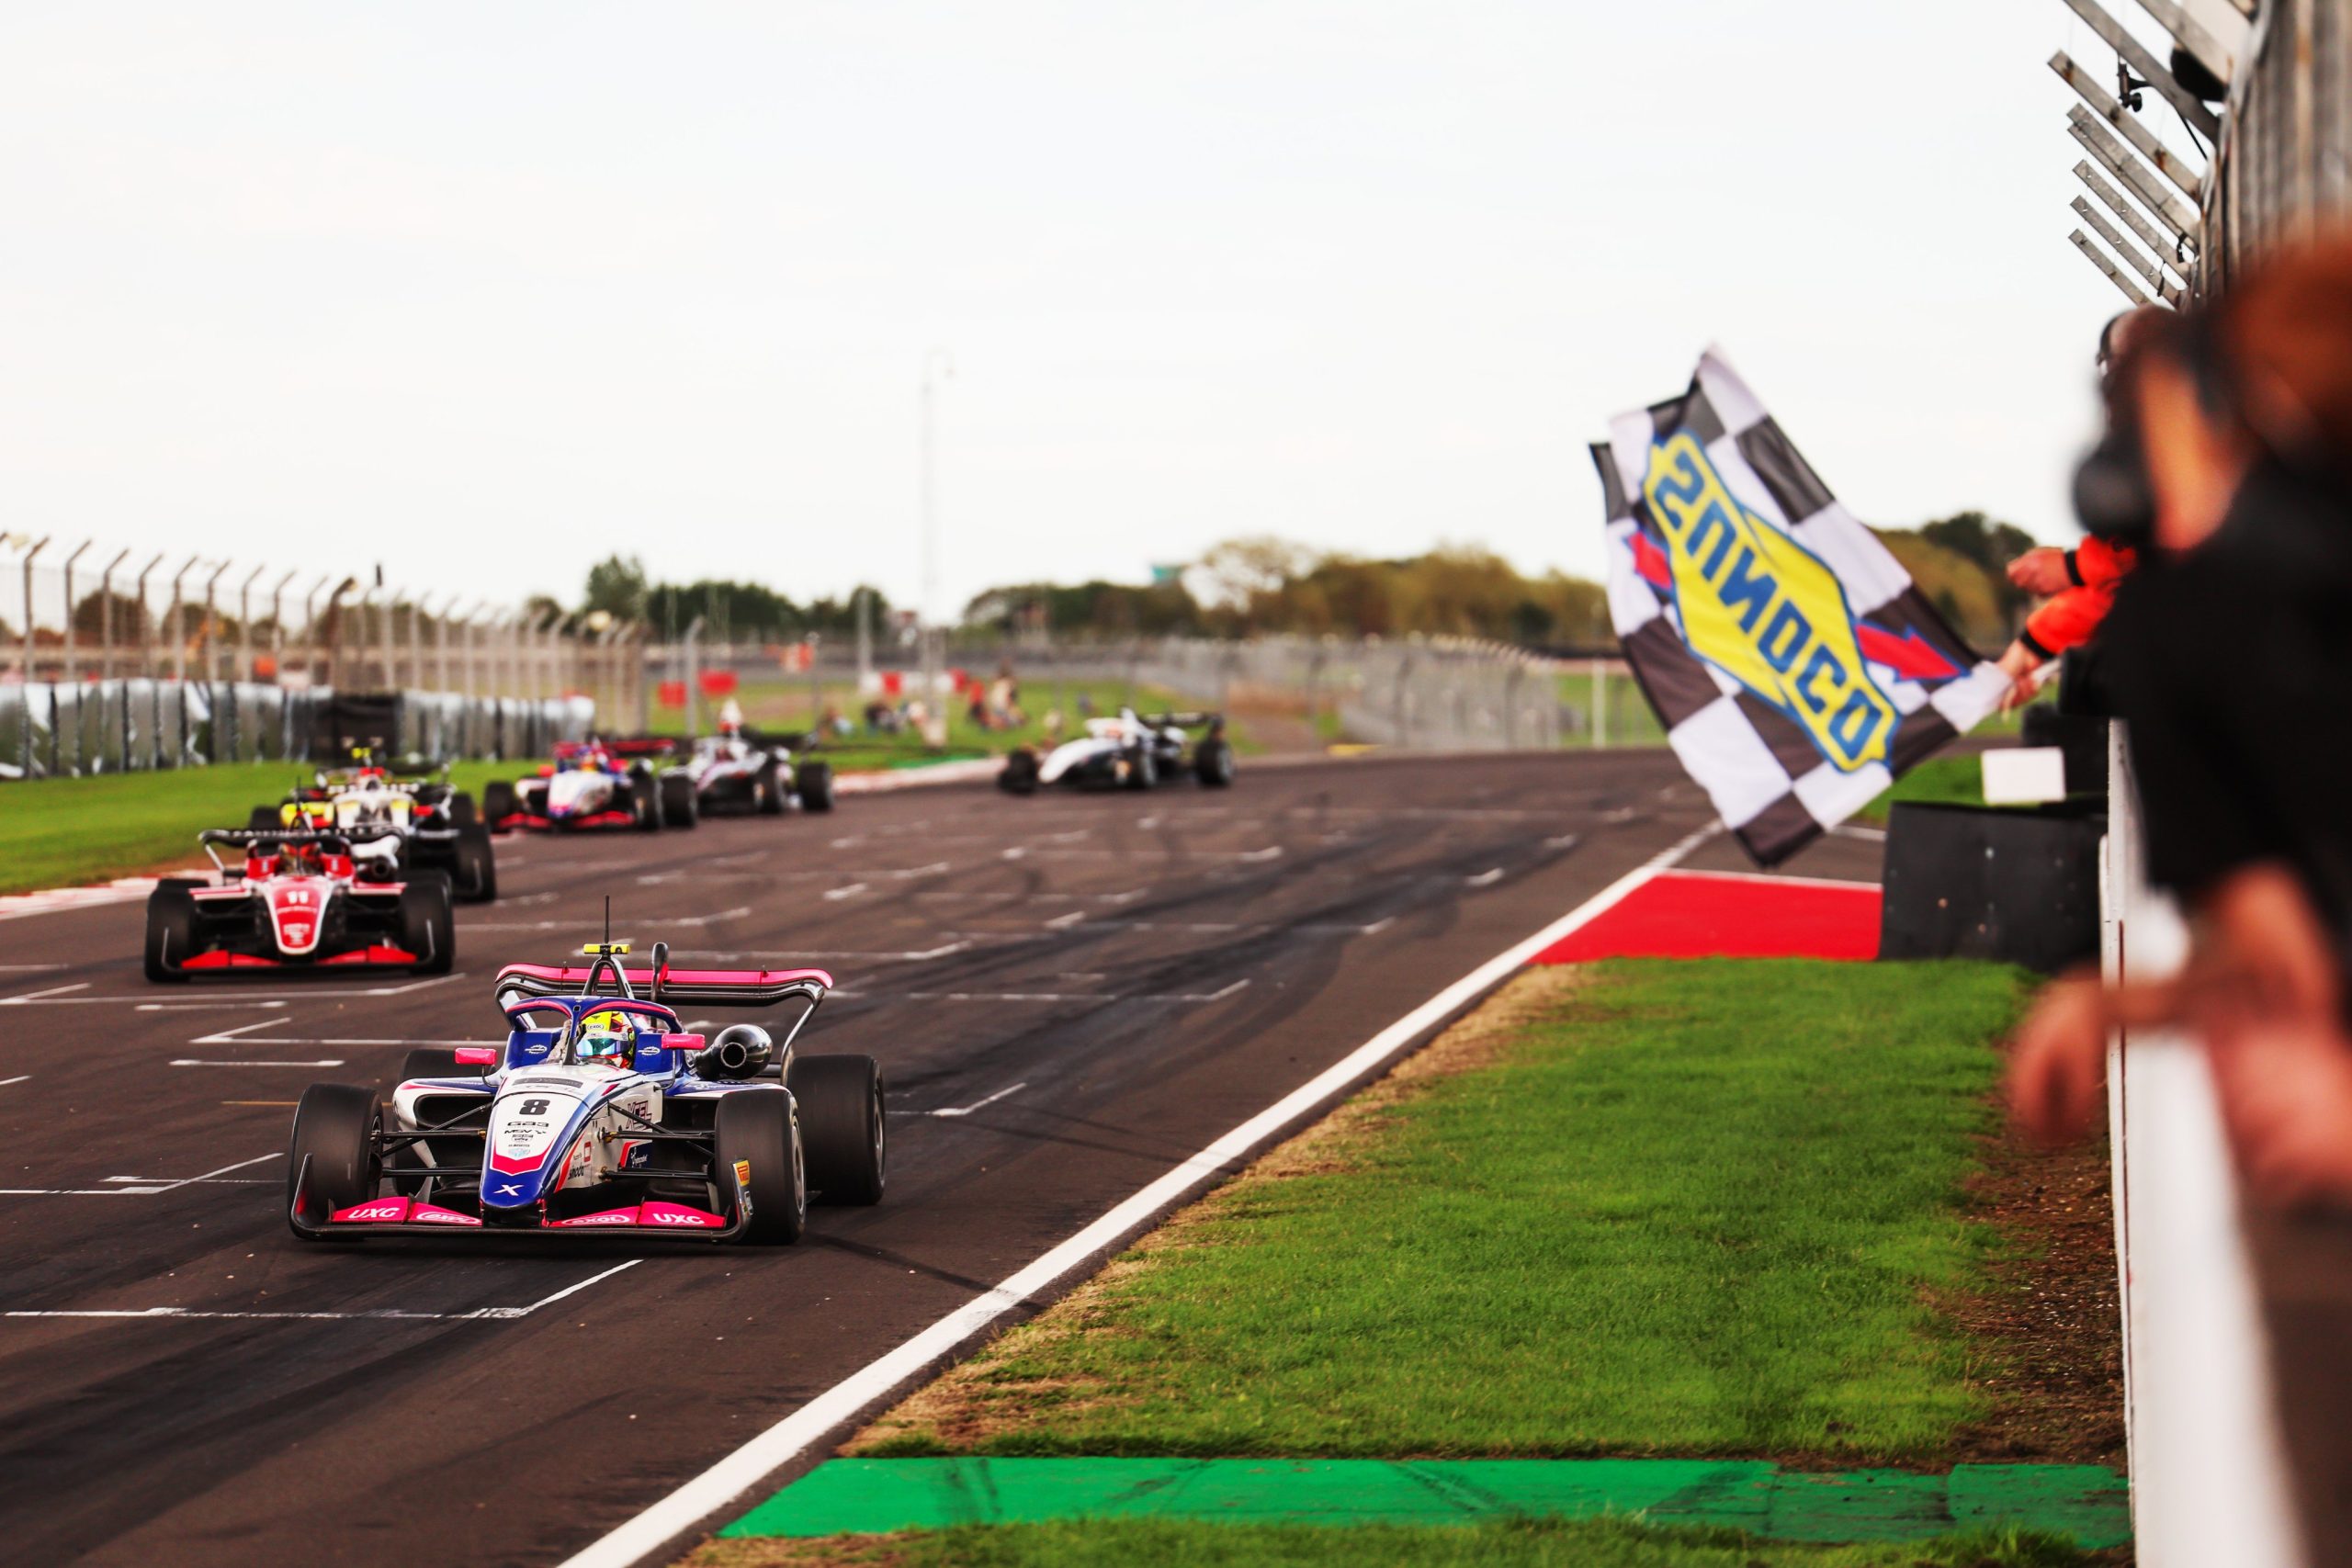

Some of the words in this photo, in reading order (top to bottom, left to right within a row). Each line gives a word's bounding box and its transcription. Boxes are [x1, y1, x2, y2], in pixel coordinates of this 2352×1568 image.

[286, 890, 310, 904] 11
[519, 1099, 550, 1116] 8
[652, 1213, 706, 1224] UXC
